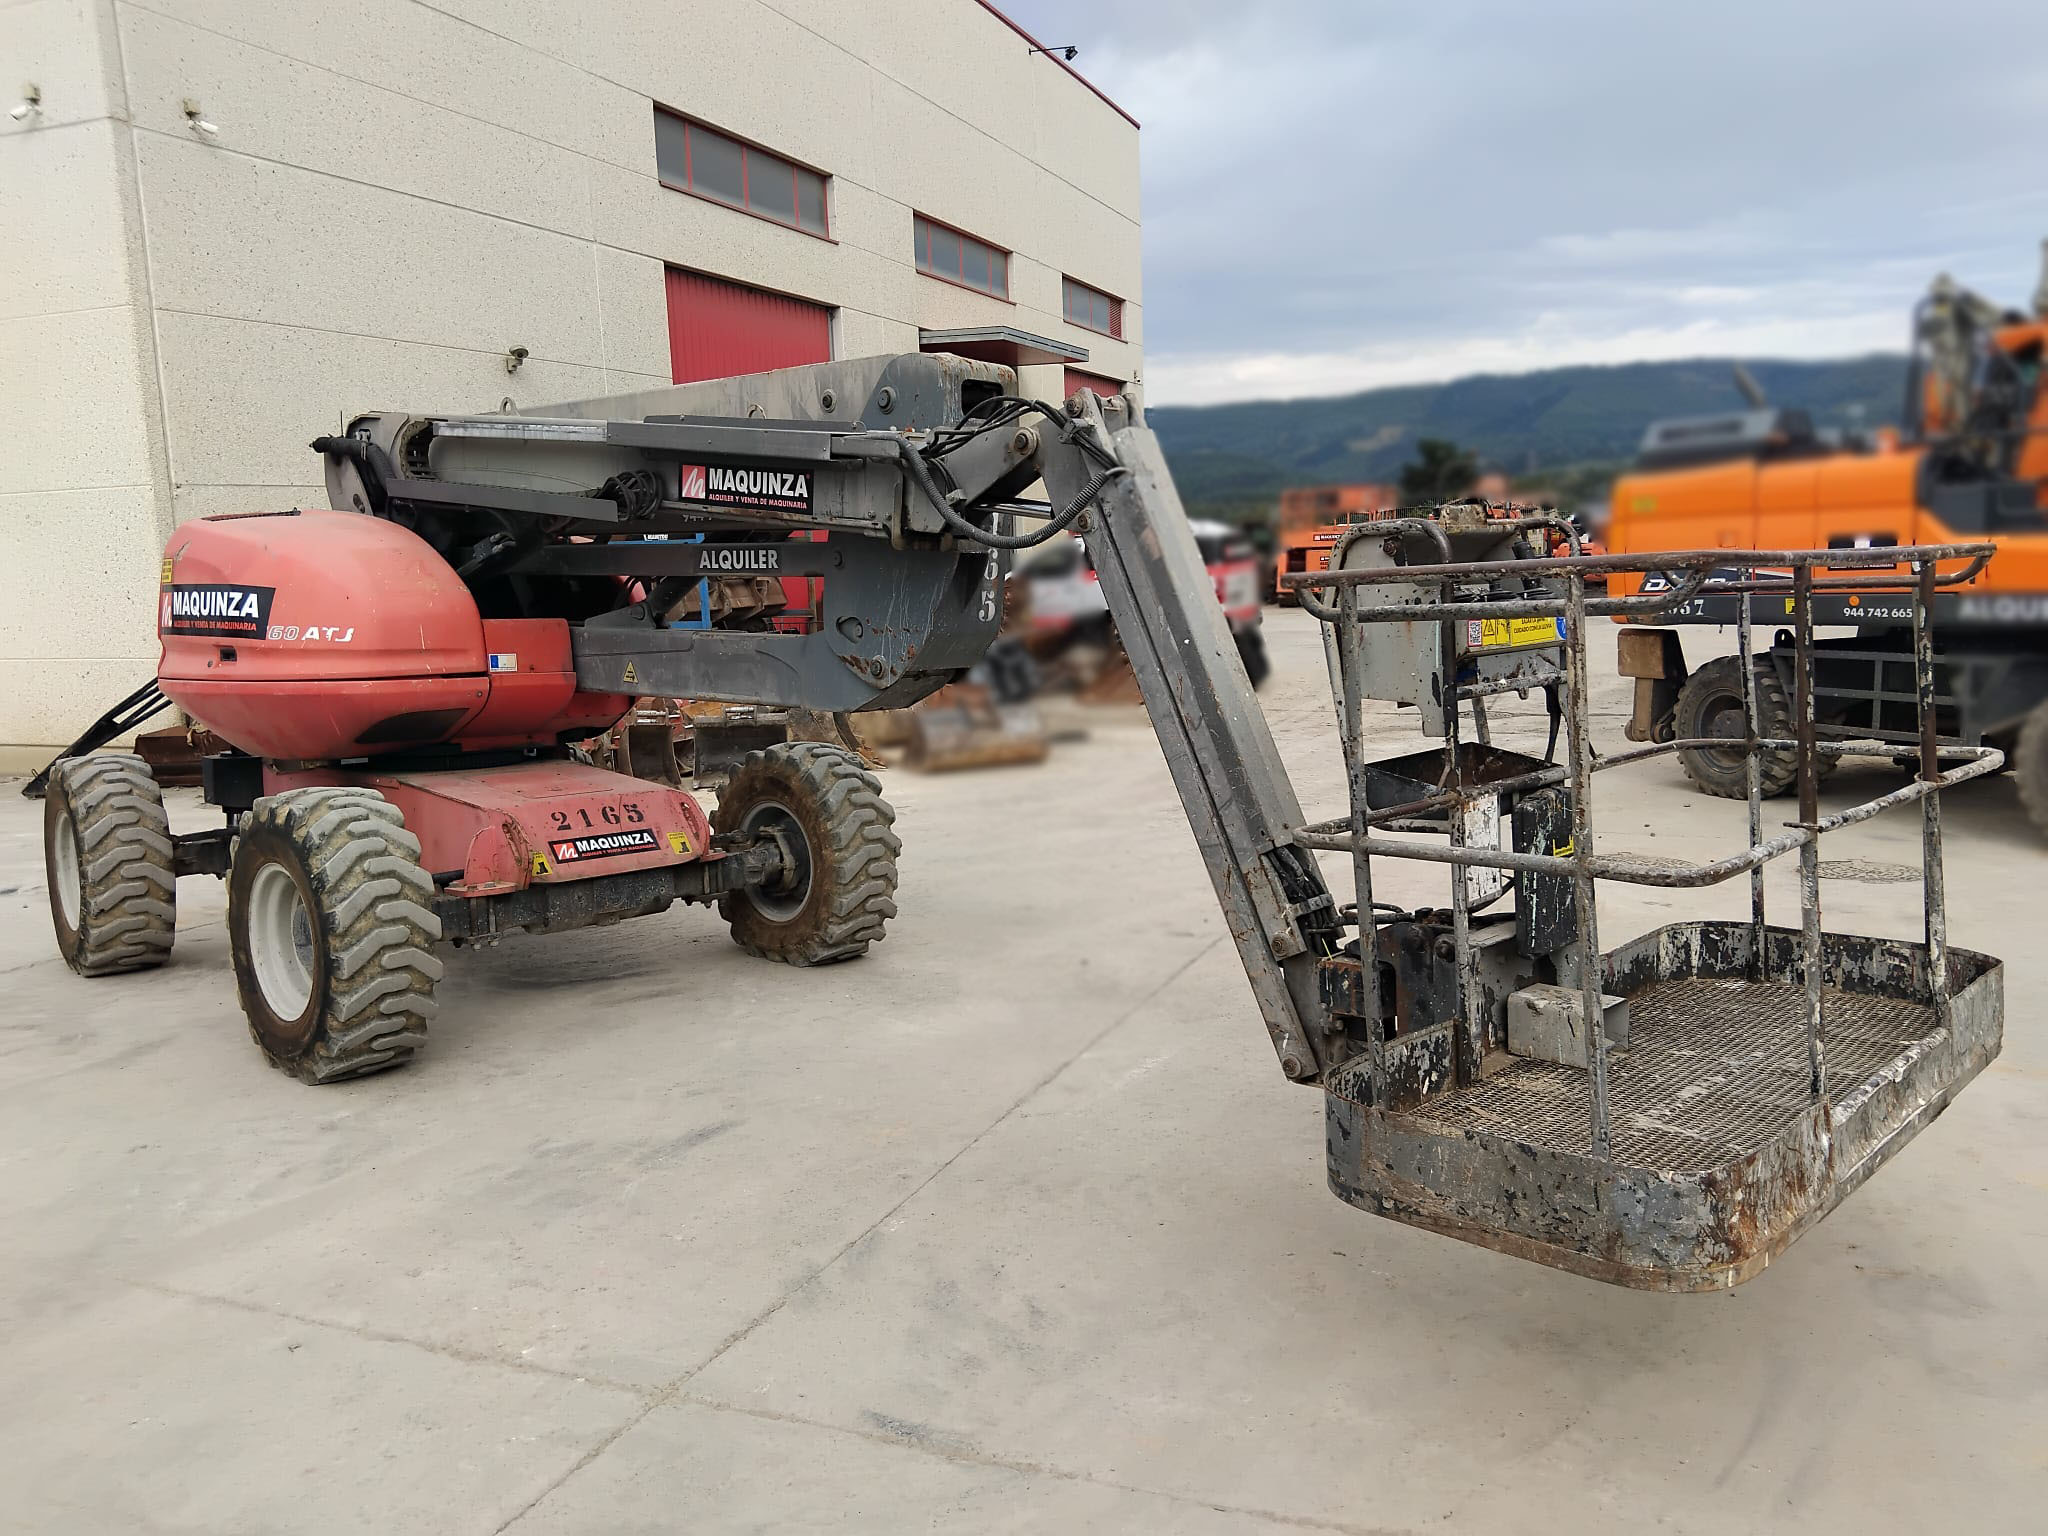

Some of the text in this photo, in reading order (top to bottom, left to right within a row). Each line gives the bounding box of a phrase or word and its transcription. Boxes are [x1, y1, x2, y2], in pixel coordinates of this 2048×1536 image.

[709, 468, 809, 498] MAQUINZA
[709, 493, 807, 509] ALQUILER Y VENTA DE MAQUINARIA
[700, 550, 779, 570] ALQUILER
[173, 591, 259, 618] MAQUINZA
[1843, 607, 1913, 618] 944 742 665
[216, 621, 257, 631] MAQUINARIA
[301, 626, 355, 642] ATJ
[551, 803, 645, 831] 2165
[575, 833, 654, 852] MAQUINZA
